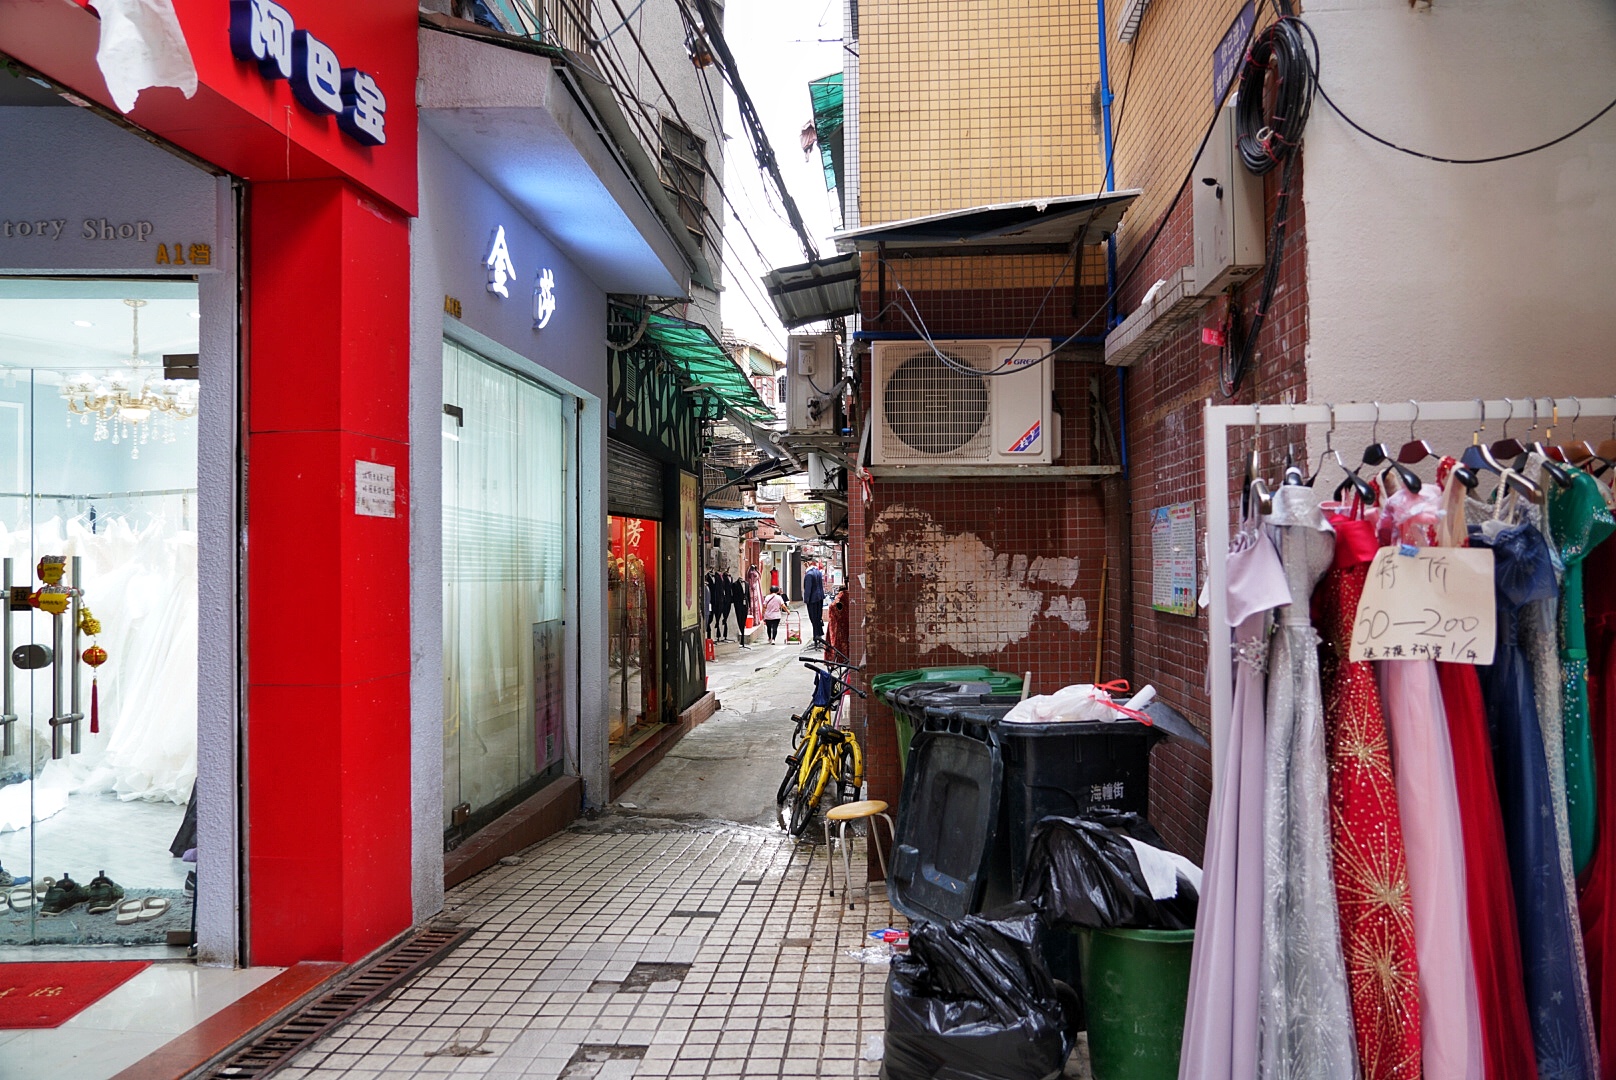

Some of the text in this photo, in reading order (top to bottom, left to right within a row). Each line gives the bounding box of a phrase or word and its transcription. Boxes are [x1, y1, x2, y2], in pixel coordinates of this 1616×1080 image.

[3, 218, 153, 242] tory Shop
[156, 243, 211, 265] A1档
[487, 224, 556, 329] 金莎
[1376, 553, 1450, 593] 特价
